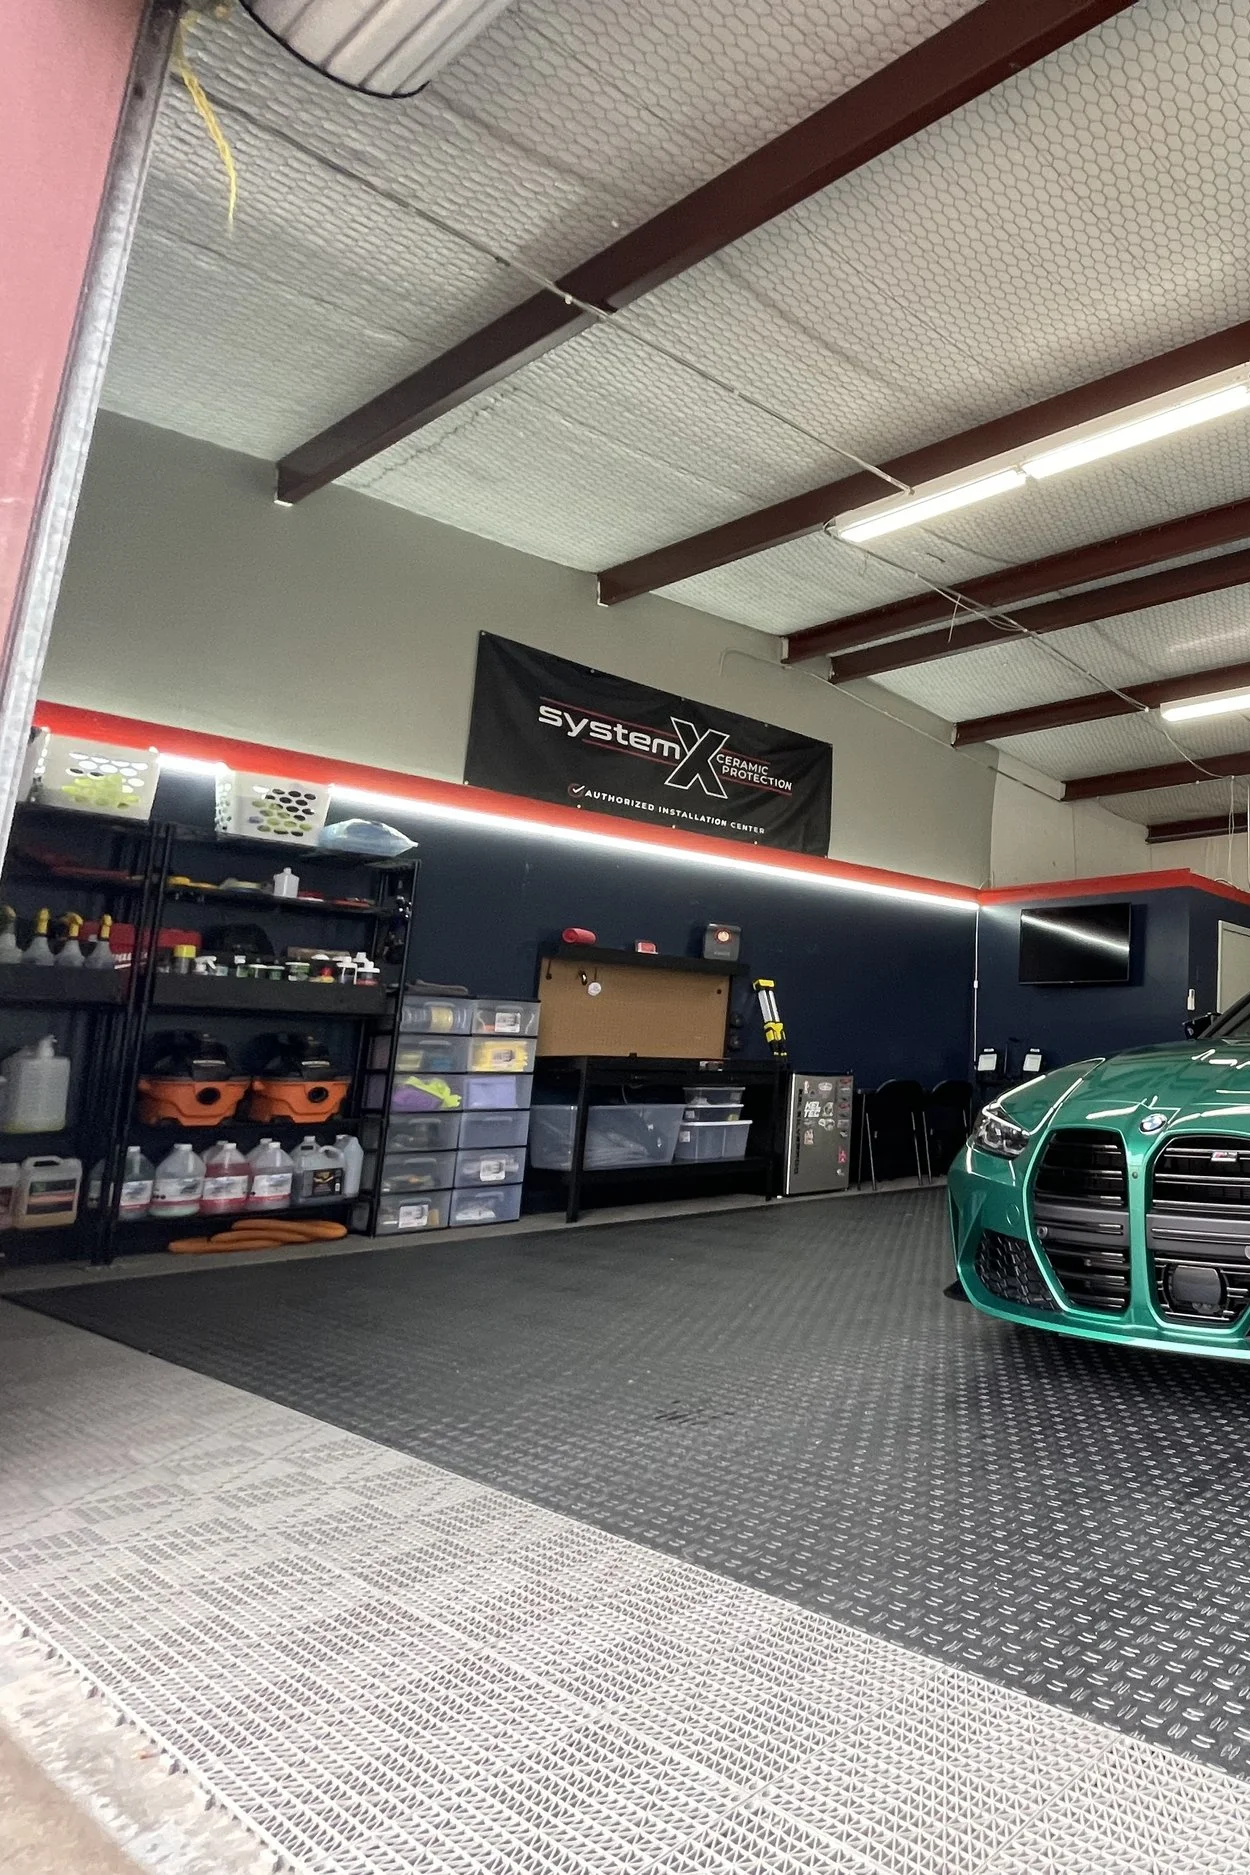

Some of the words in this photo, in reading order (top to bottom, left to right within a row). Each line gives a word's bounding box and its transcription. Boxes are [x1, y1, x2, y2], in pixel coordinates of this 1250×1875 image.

[716, 754, 769, 775] CERAMIC
[722, 765, 793, 791] PROTECTION
[584, 789, 655, 811] AUTHORIZED
[658, 806, 728, 827] INSTALLATION
[730, 821, 766, 834] CENTER
